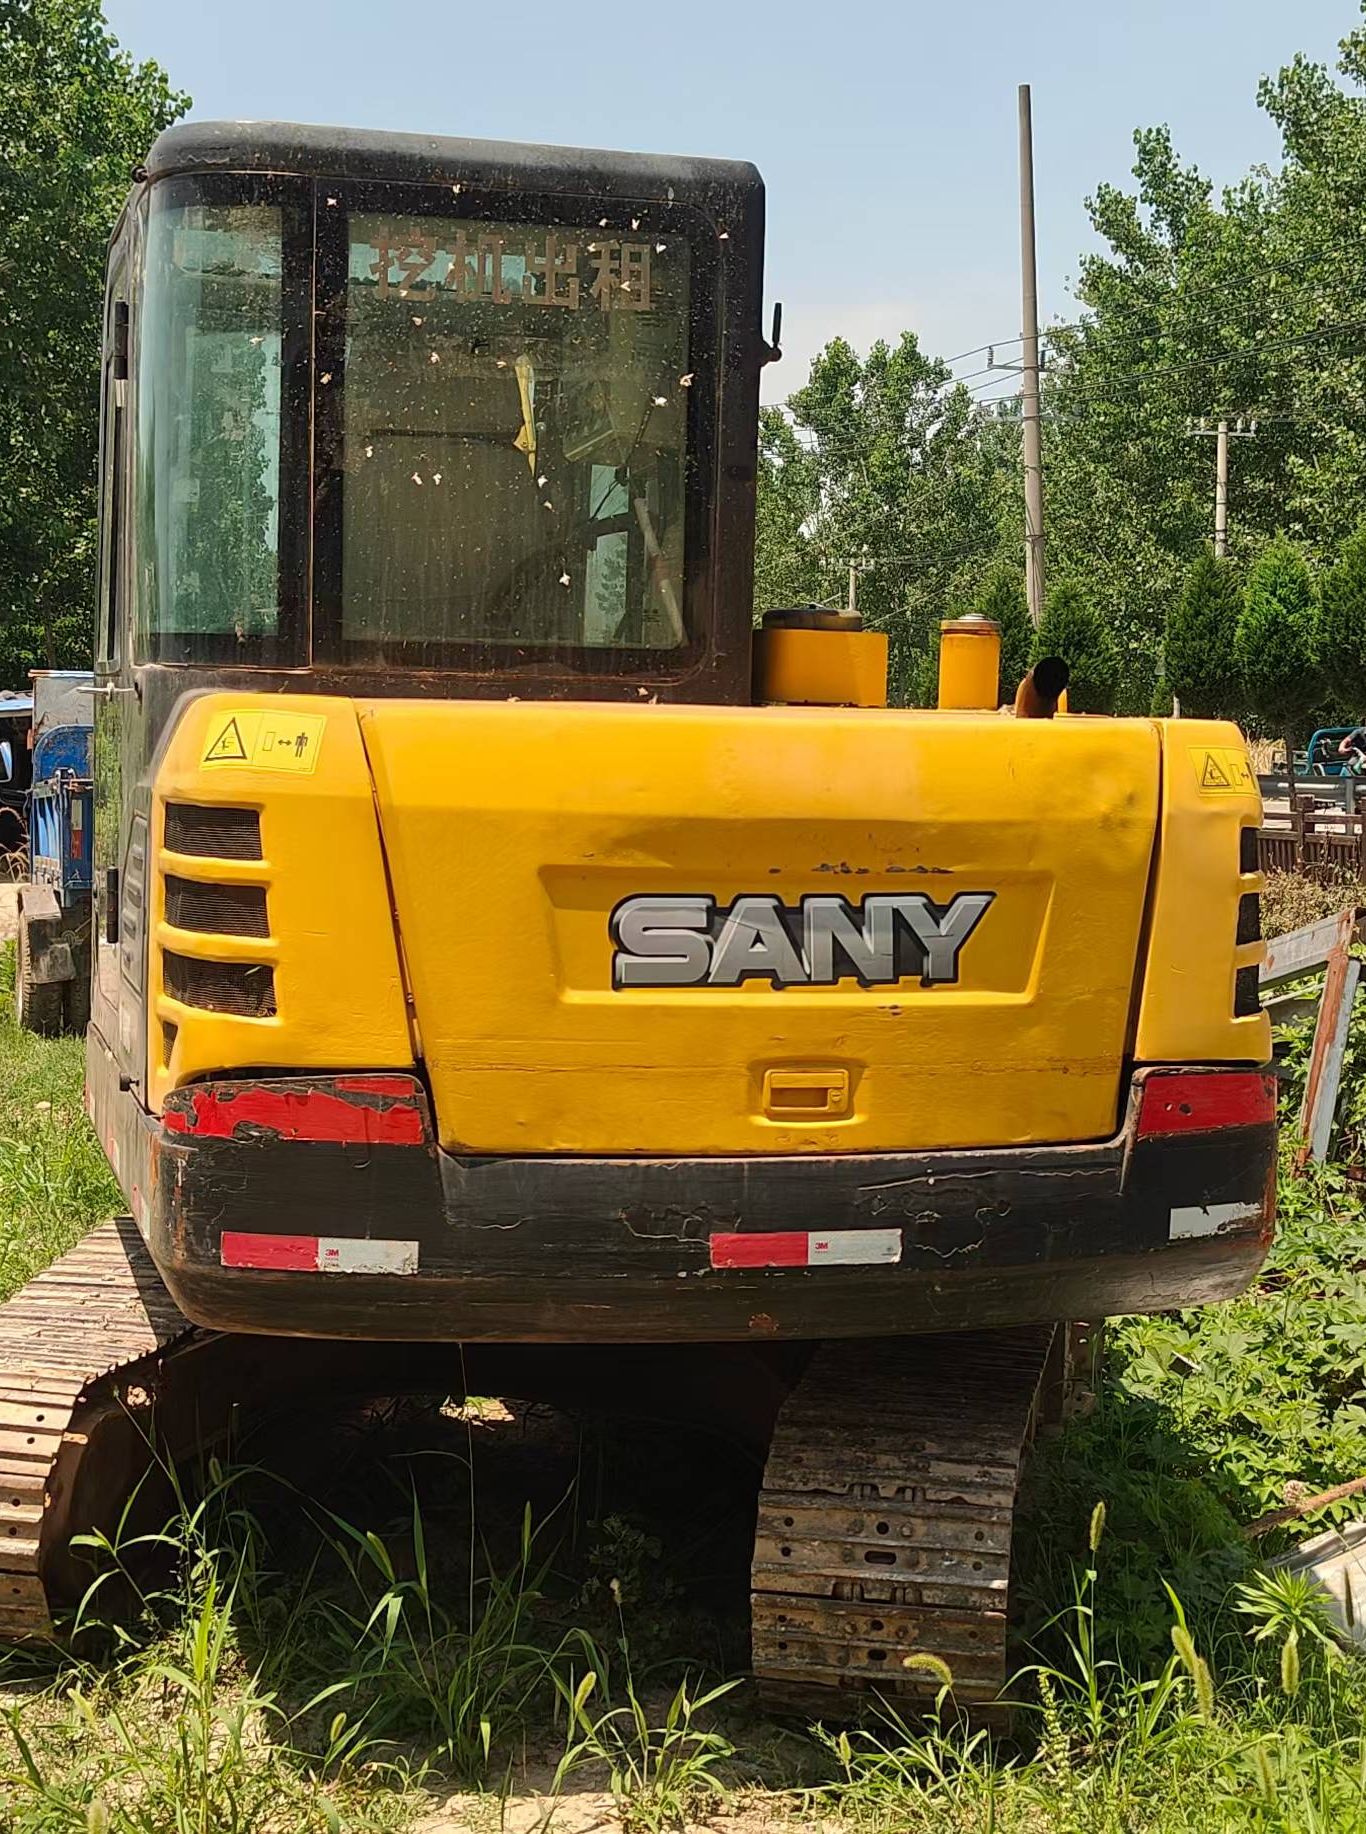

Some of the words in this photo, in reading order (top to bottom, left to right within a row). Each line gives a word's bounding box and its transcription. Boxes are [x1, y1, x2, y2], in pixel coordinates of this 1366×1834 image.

[370, 224, 651, 311] 挖机出租
[609, 893, 996, 990] SANY
[325, 1248, 339, 1257] 3M
[815, 1242, 828, 1250] 3M
